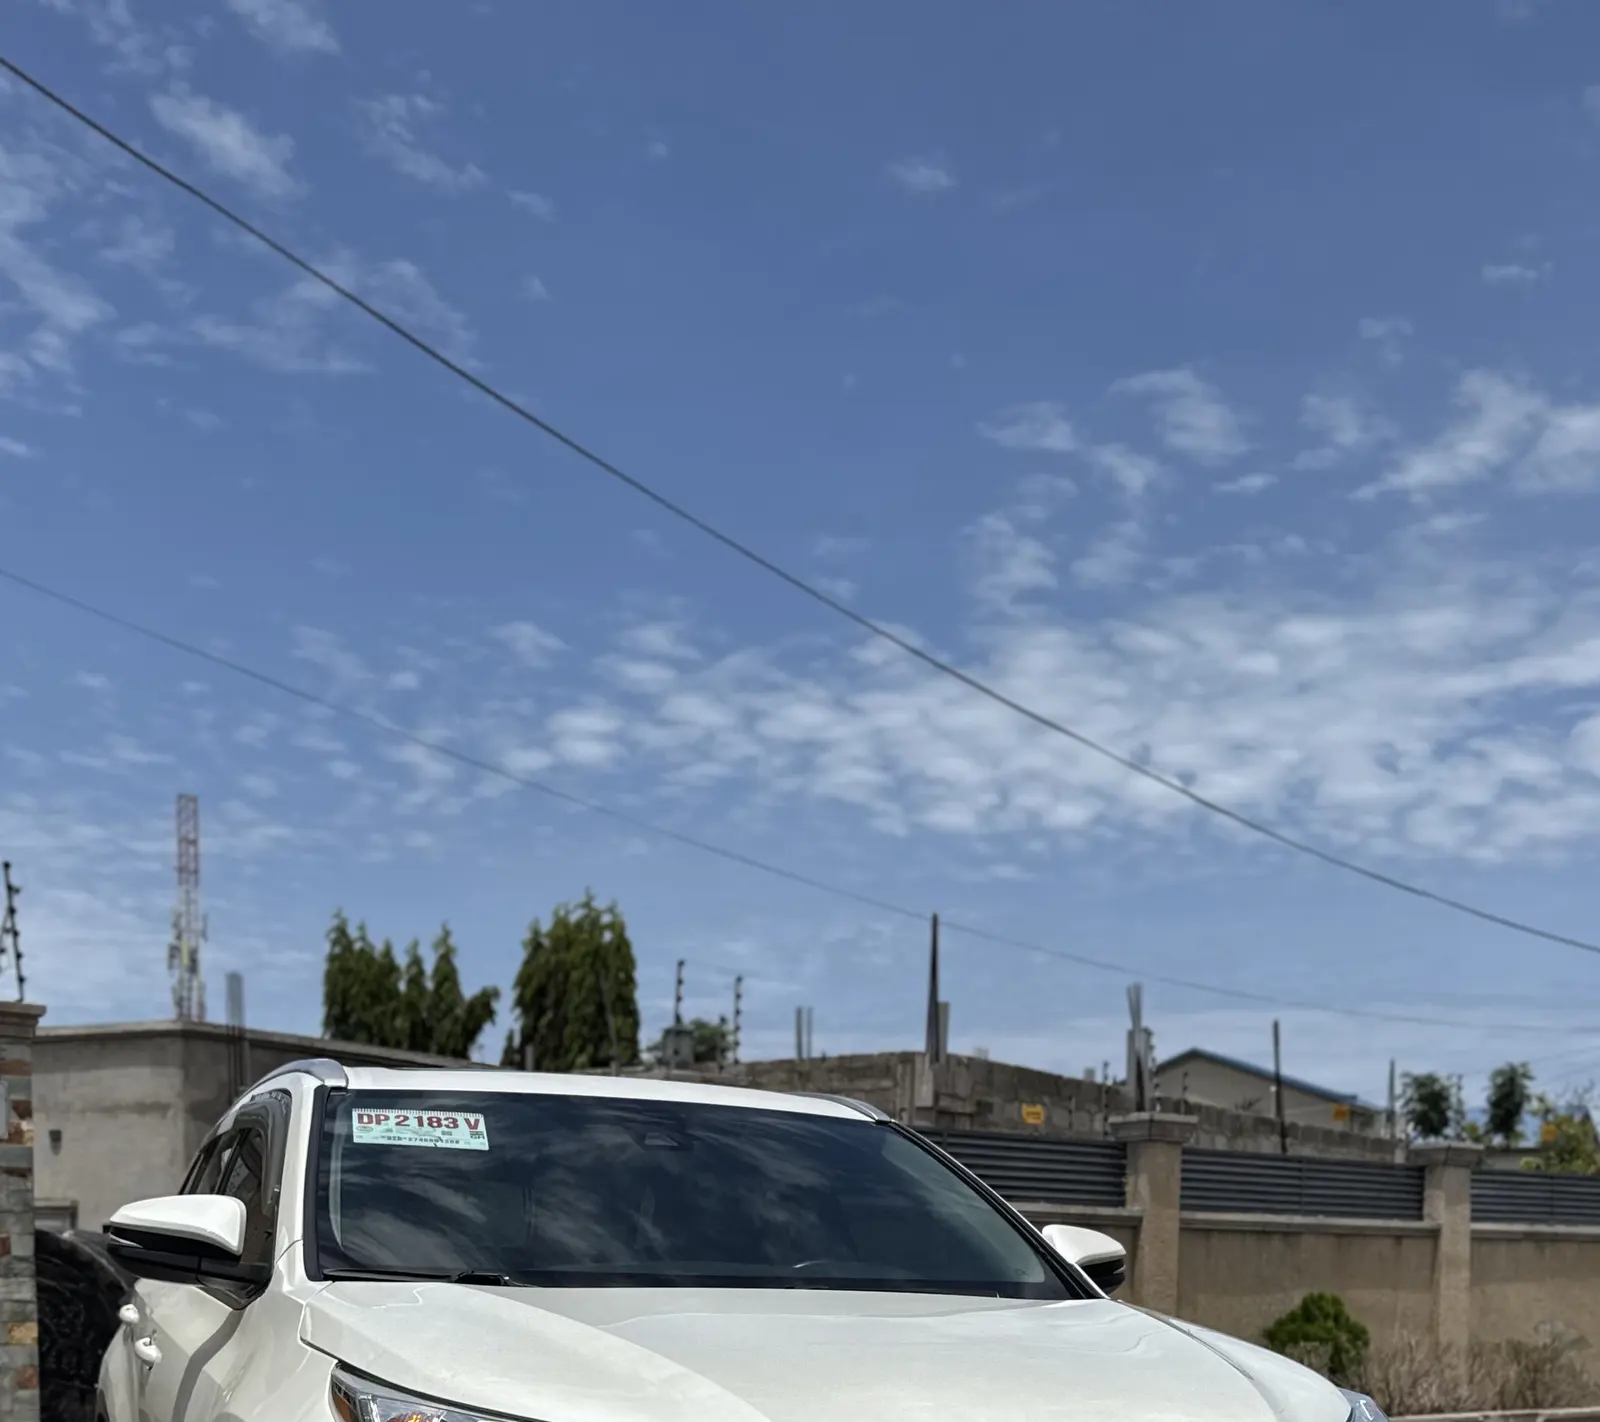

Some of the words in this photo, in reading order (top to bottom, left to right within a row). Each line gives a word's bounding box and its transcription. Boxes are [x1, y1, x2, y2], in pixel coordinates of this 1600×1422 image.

[357, 1113, 390, 1126] DP
[394, 1115, 459, 1130] 2183
[464, 1118, 480, 1130] V
